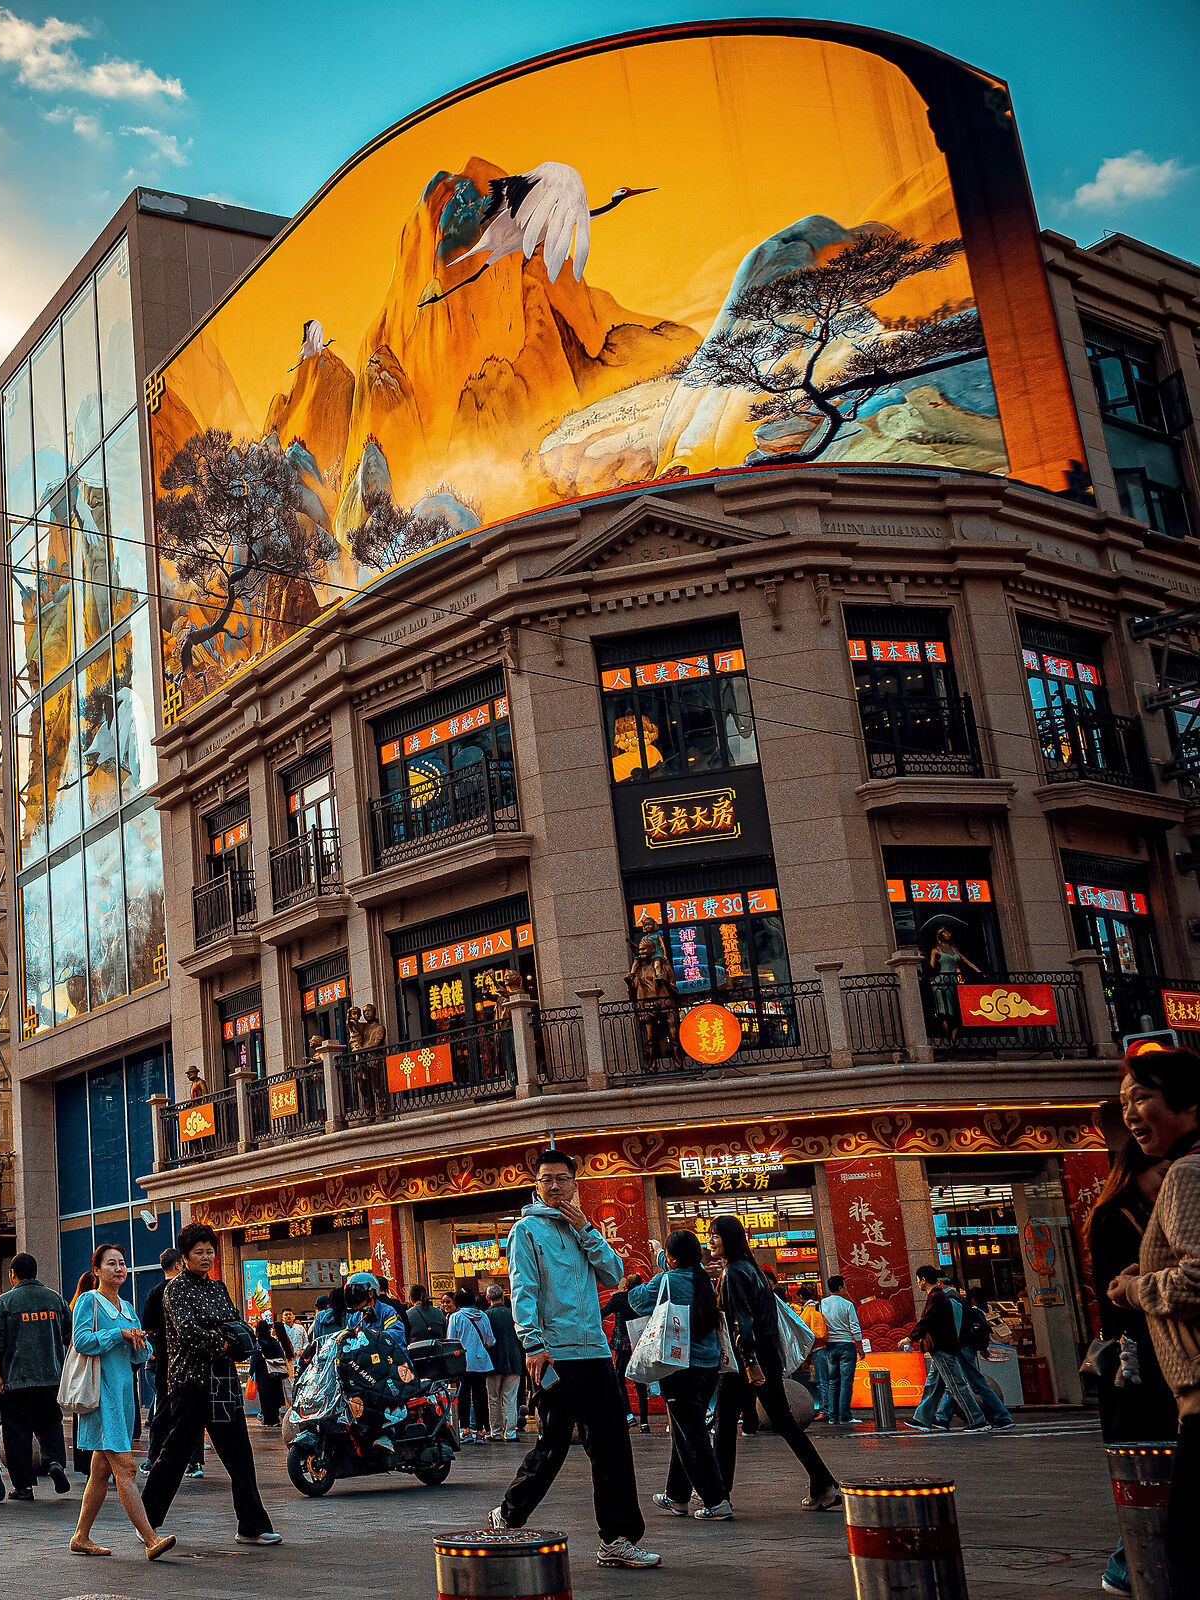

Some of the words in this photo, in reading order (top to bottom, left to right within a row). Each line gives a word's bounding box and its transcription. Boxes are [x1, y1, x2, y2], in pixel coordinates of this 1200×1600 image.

[849, 642, 942, 662] 上海本帮菜
[611, 653, 734, 688] 人气美食餐厅
[390, 699, 509, 760] 上海本帮融合菜
[644, 796, 734, 838] 真老大房
[887, 882, 982, 901] 一品汤包馆
[636, 893, 767, 925] 人均消费30元
[429, 979, 464, 1012] 美食楼
[703, 1151, 783, 1169] 中华老字号
[764, 1163, 784, 1171] Brand
[699, 1172, 770, 1194] 真老大房
